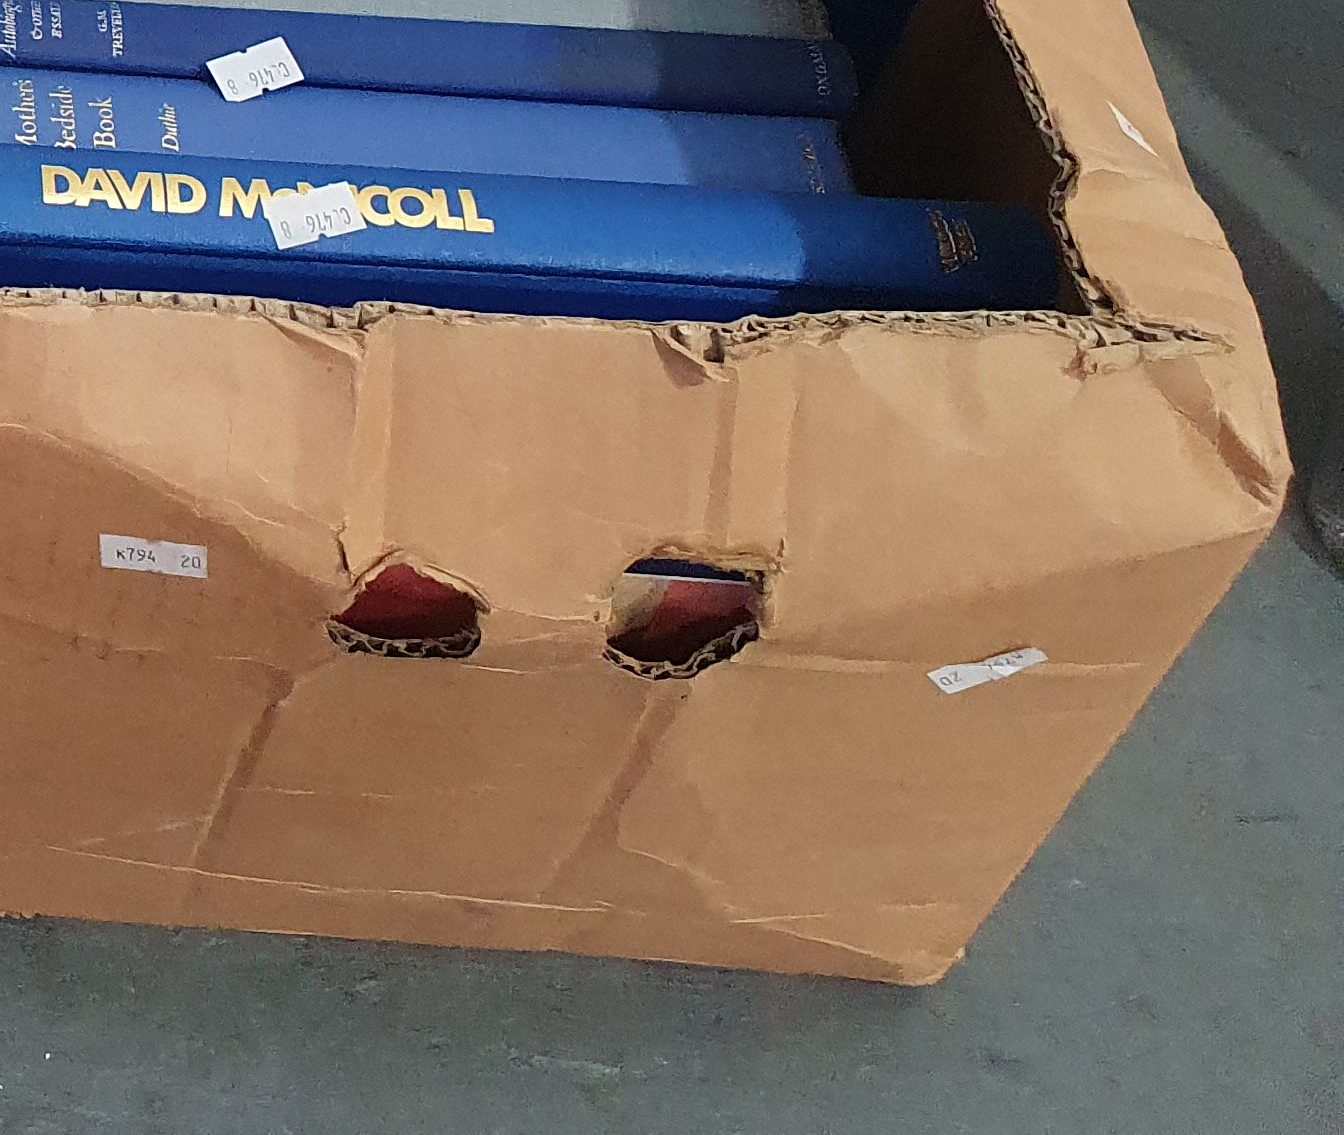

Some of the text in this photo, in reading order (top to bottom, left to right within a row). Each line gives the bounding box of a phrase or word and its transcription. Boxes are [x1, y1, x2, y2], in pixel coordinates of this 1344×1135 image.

[227, 79, 239, 95] 8
[92, 96, 117, 149] Book
[40, 164, 209, 216] DAVID
[282, 221, 293, 237] 8
